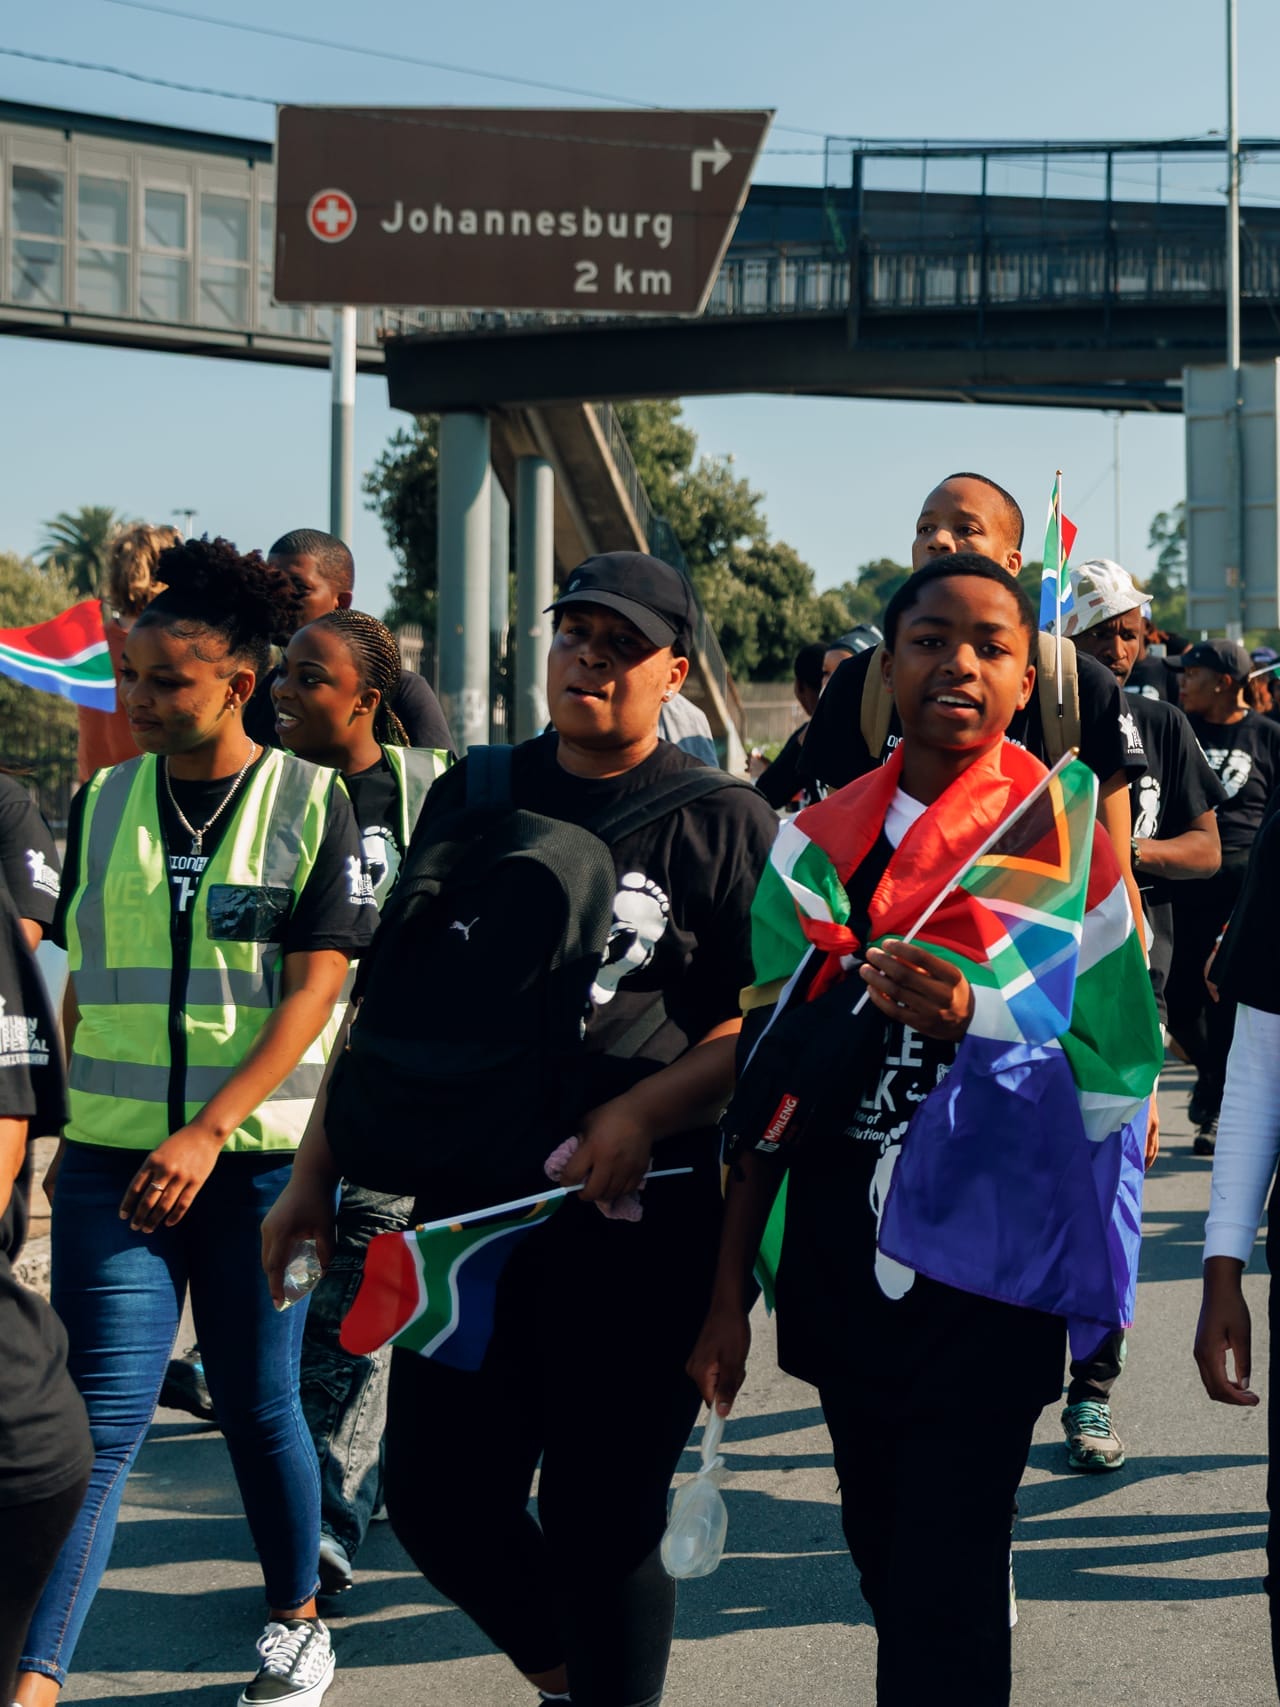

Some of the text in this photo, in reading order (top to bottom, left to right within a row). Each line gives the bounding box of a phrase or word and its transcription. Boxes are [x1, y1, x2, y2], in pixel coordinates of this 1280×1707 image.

[381, 200, 673, 249] Johannesburg
[574, 261, 672, 295] 2 km
[763, 1098, 798, 1142] MPILENG
